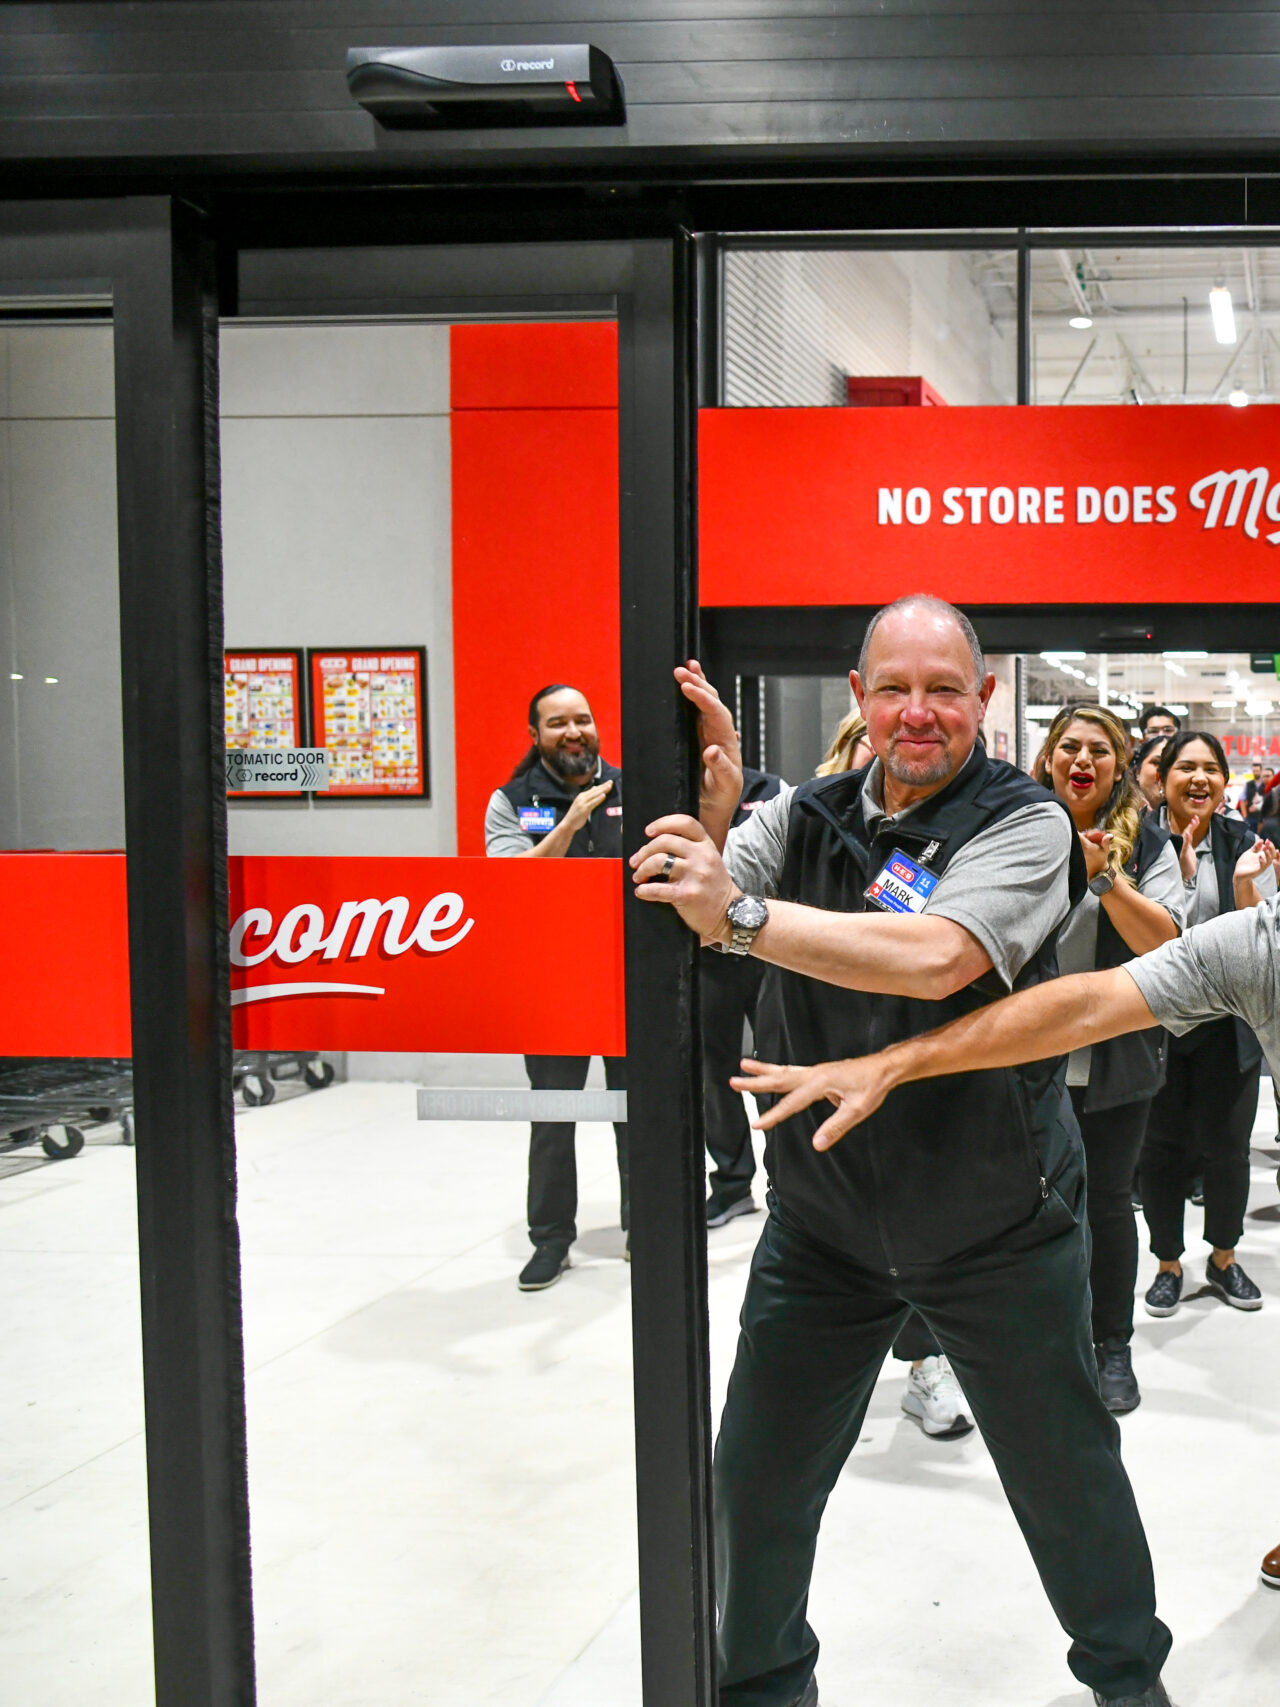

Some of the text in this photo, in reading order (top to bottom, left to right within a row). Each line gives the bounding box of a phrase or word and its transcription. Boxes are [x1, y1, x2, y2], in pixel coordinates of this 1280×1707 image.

[517, 58, 554, 71] record
[877, 487, 931, 525] NO
[942, 486, 1064, 525] STORE
[1076, 485, 1177, 524] DOES
[287, 752, 325, 765] DOOR
[255, 768, 298, 781] record
[882, 878, 914, 907] MARK
[229, 891, 476, 967] come
